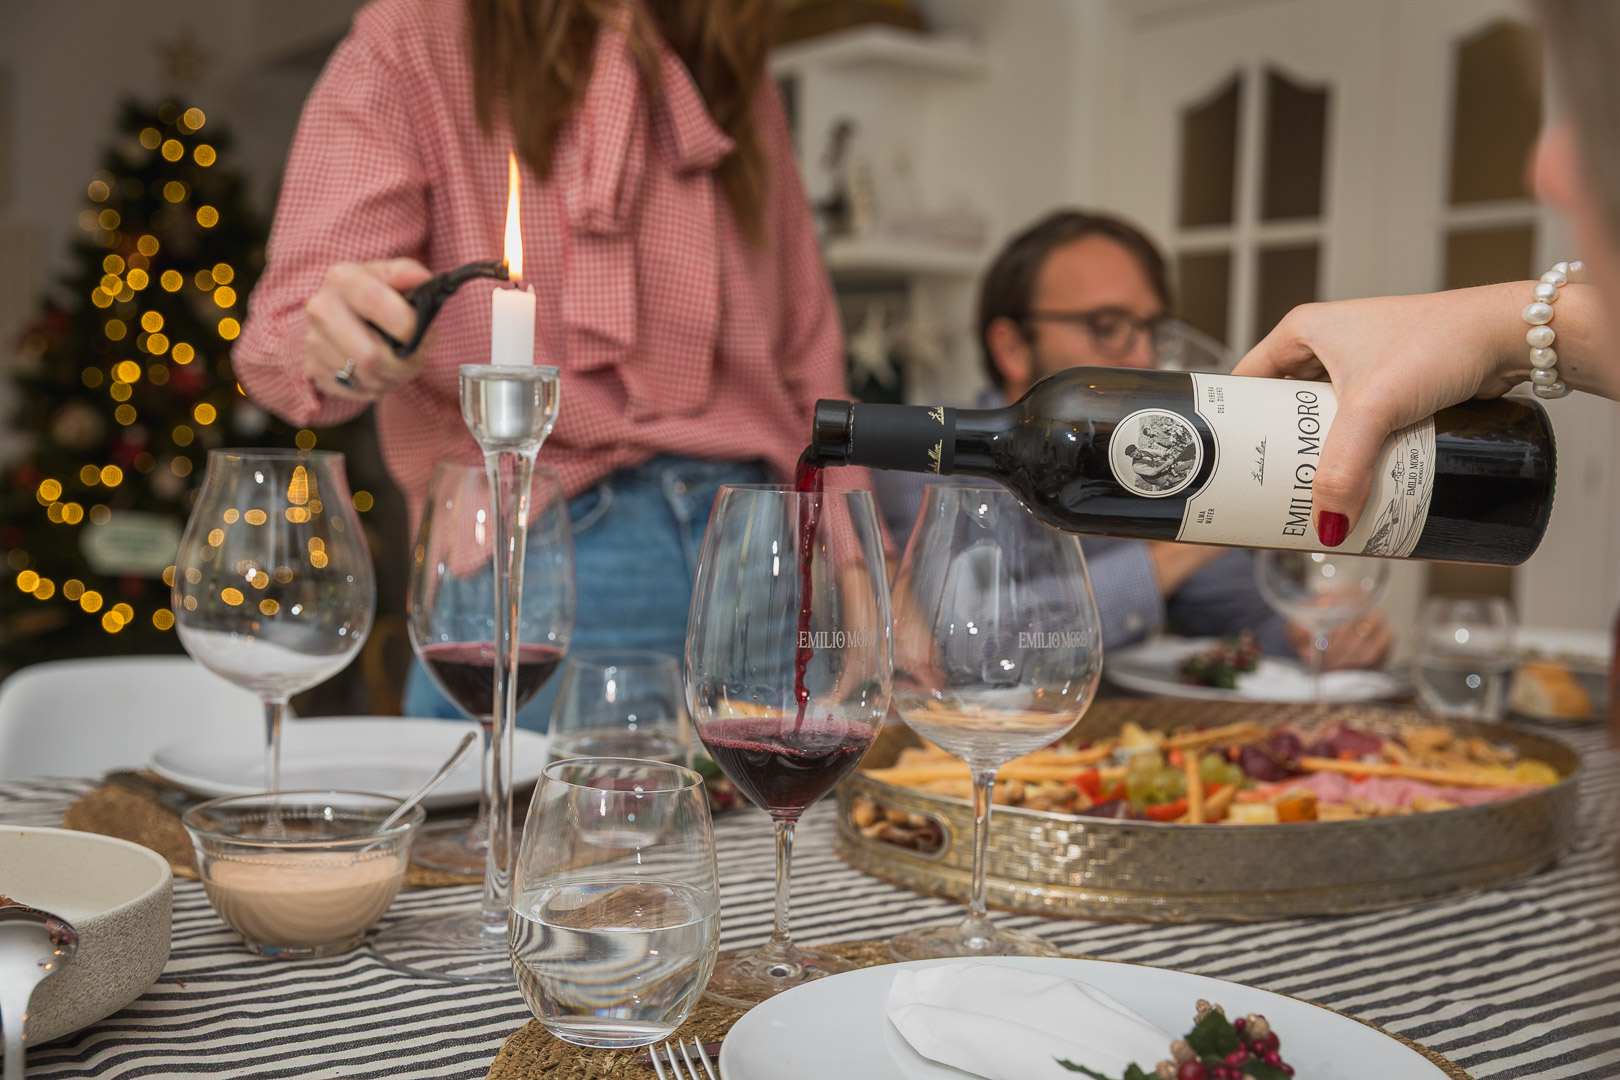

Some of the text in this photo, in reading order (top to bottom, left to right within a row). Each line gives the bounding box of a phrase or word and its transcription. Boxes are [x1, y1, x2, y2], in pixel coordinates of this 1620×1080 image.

[1282, 390, 1320, 537] EMILIO MORO
[1406, 448, 1420, 497] EMILIO MORO
[1417, 461, 1425, 485] BODEGAS
[1197, 510, 1206, 524] ALMA
[798, 630, 846, 649] EMILIO
[1018, 630, 1088, 649] EMILIO MORO
